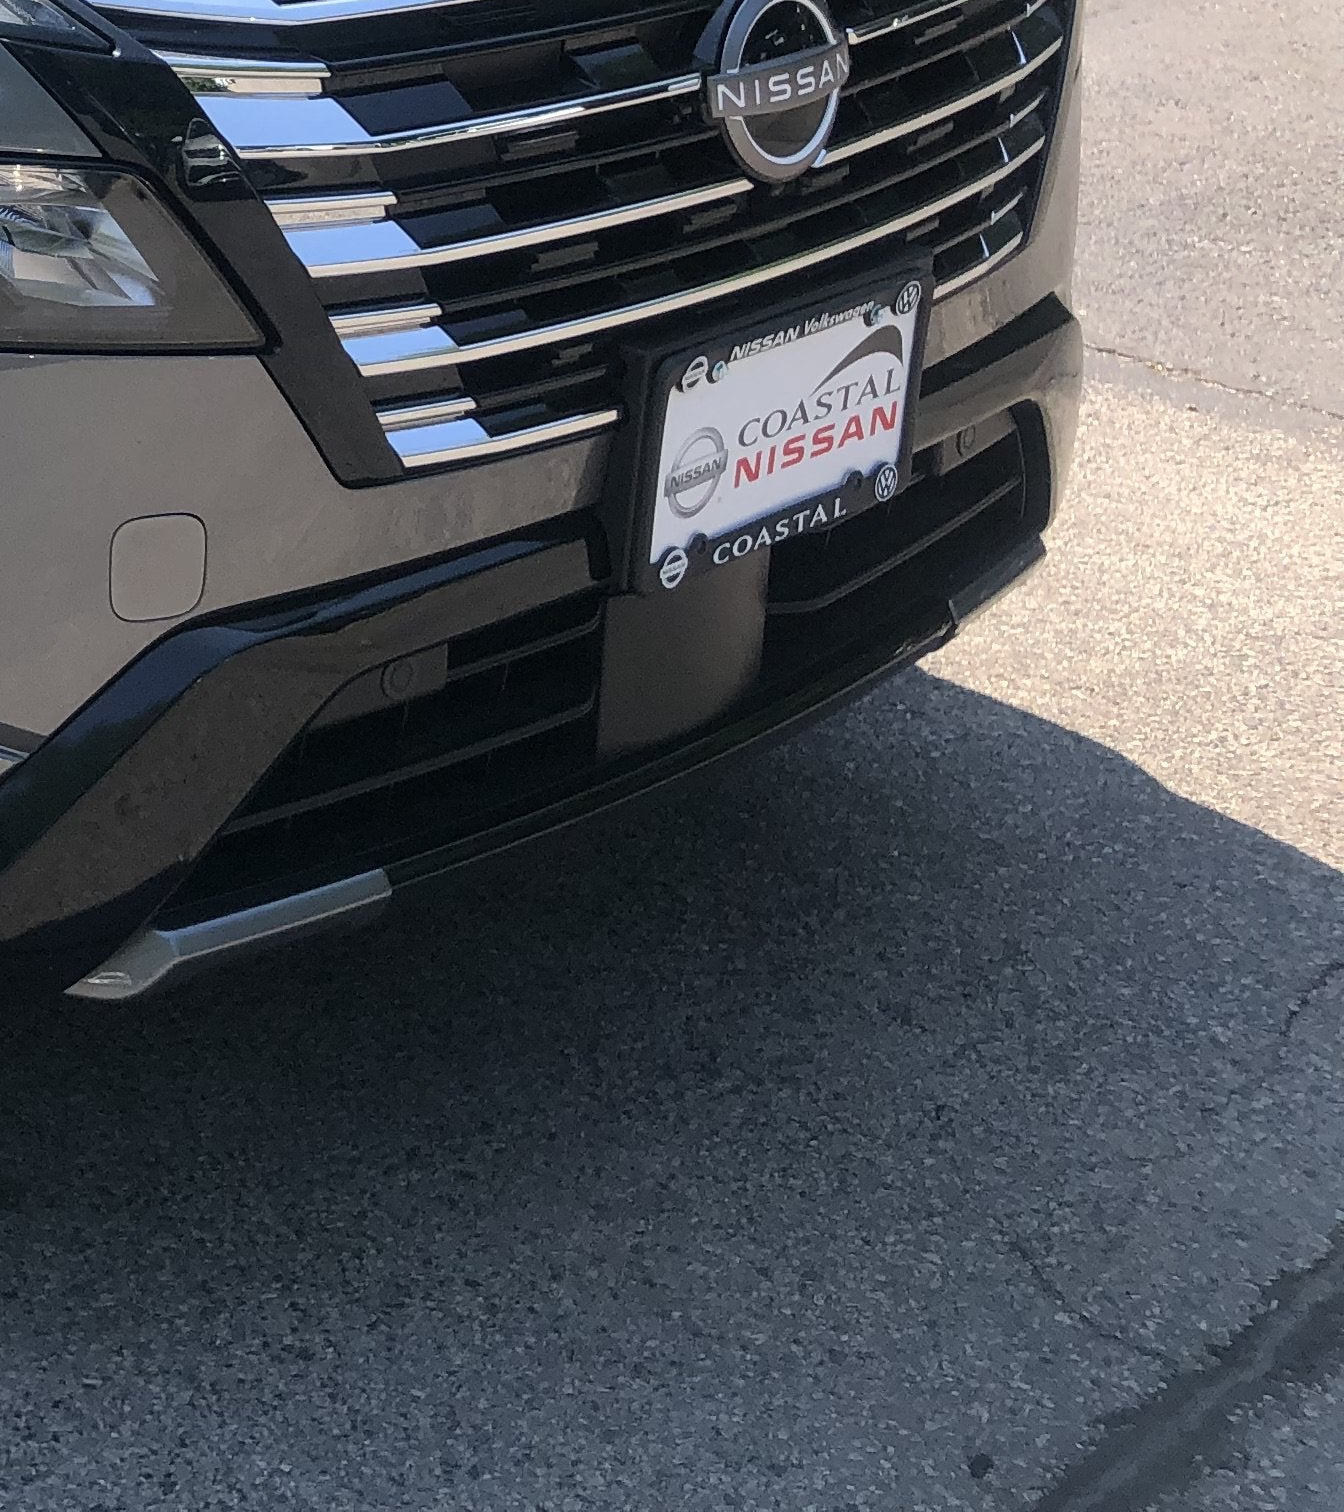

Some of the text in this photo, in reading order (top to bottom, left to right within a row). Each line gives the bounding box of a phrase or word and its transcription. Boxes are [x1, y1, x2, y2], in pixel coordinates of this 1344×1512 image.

[716, 53, 849, 110] NISSAN
[729, 300, 875, 361] NISSAN Volkswagen
[738, 367, 901, 447] COASTAL
[670, 456, 722, 488] NISSAN
[732, 400, 899, 489] NISSAN
[713, 497, 847, 564] COASTAL
